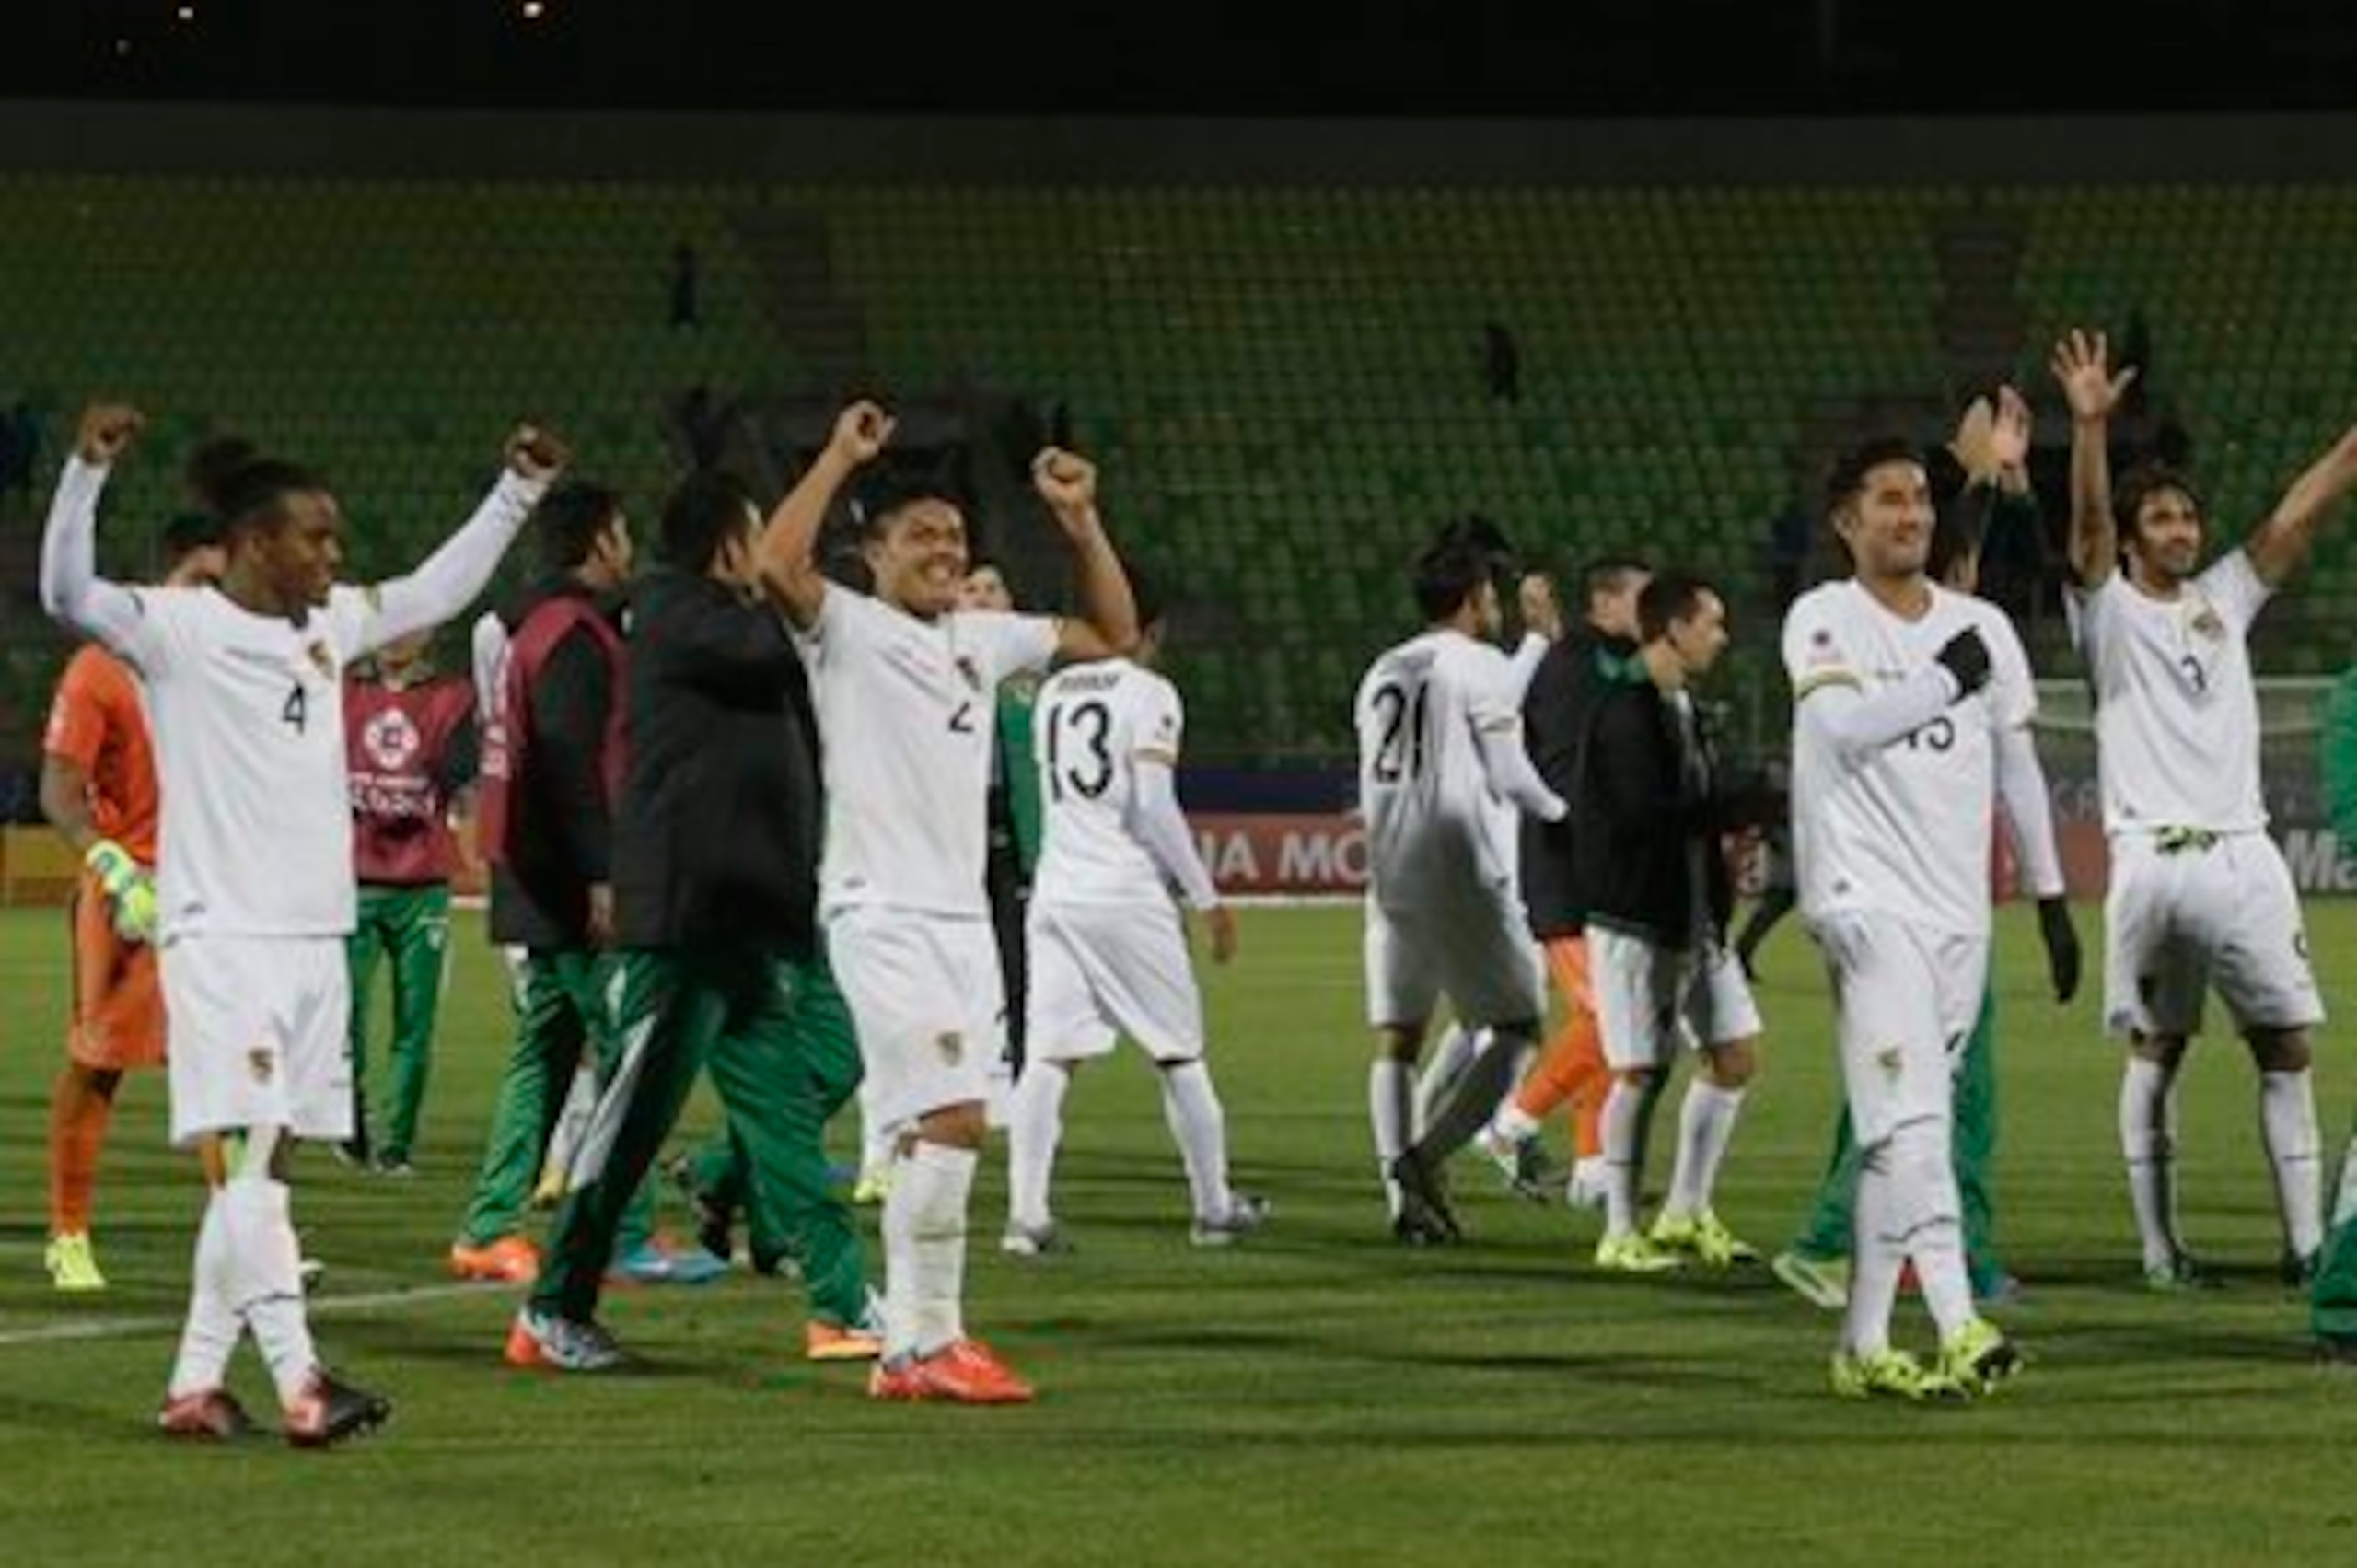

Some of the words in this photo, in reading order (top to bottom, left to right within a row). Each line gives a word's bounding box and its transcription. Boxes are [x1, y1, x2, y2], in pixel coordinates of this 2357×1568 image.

[2181, 654, 2206, 692] 3
[283, 683, 305, 736] 4
[949, 700, 974, 733] 2
[1372, 680, 1428, 784] 21
[1048, 701, 1113, 803] 13
